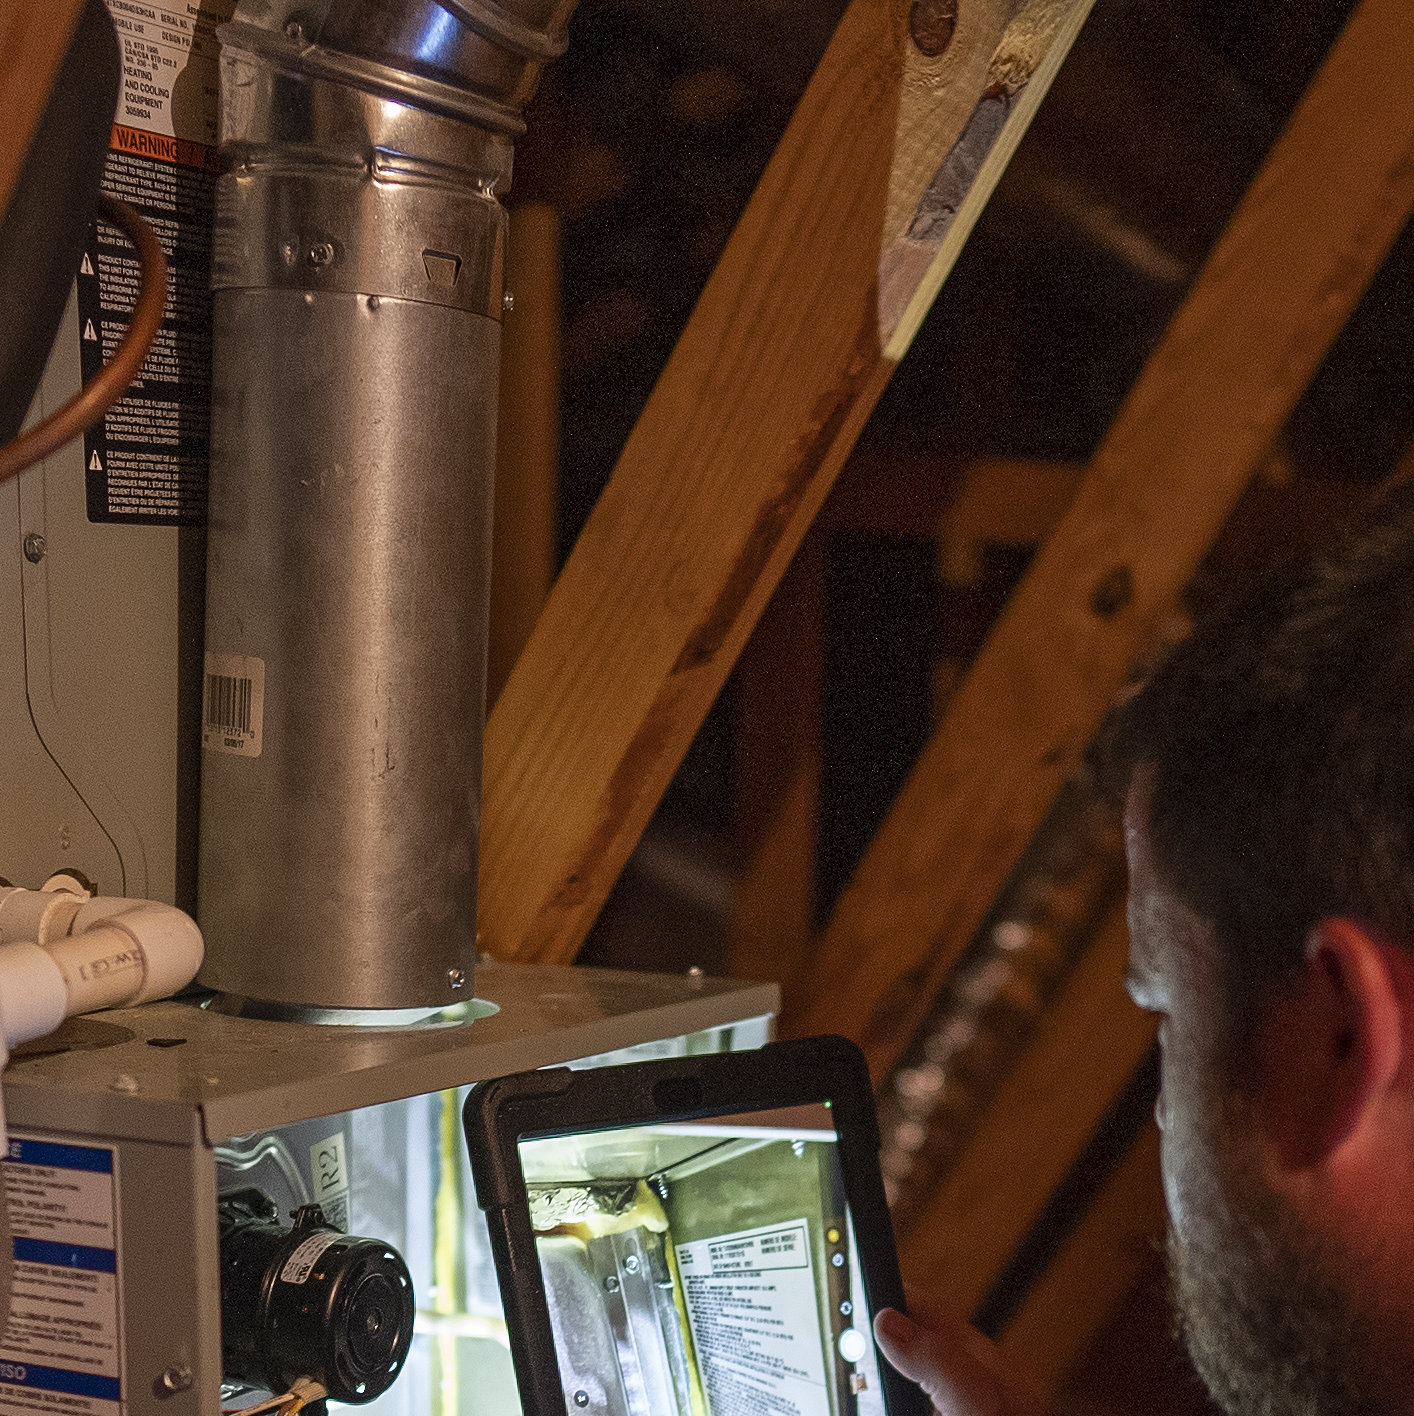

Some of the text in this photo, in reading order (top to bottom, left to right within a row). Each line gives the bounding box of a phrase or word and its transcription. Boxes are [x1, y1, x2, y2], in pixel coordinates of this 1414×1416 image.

[123, 66, 152, 82] HEATING
[125, 79, 170, 99] AND COOLING
[125, 92, 163, 110] EQUIPMENT
[116, 128, 178, 159] WARNING
[319, 1145, 341, 1192] R2
